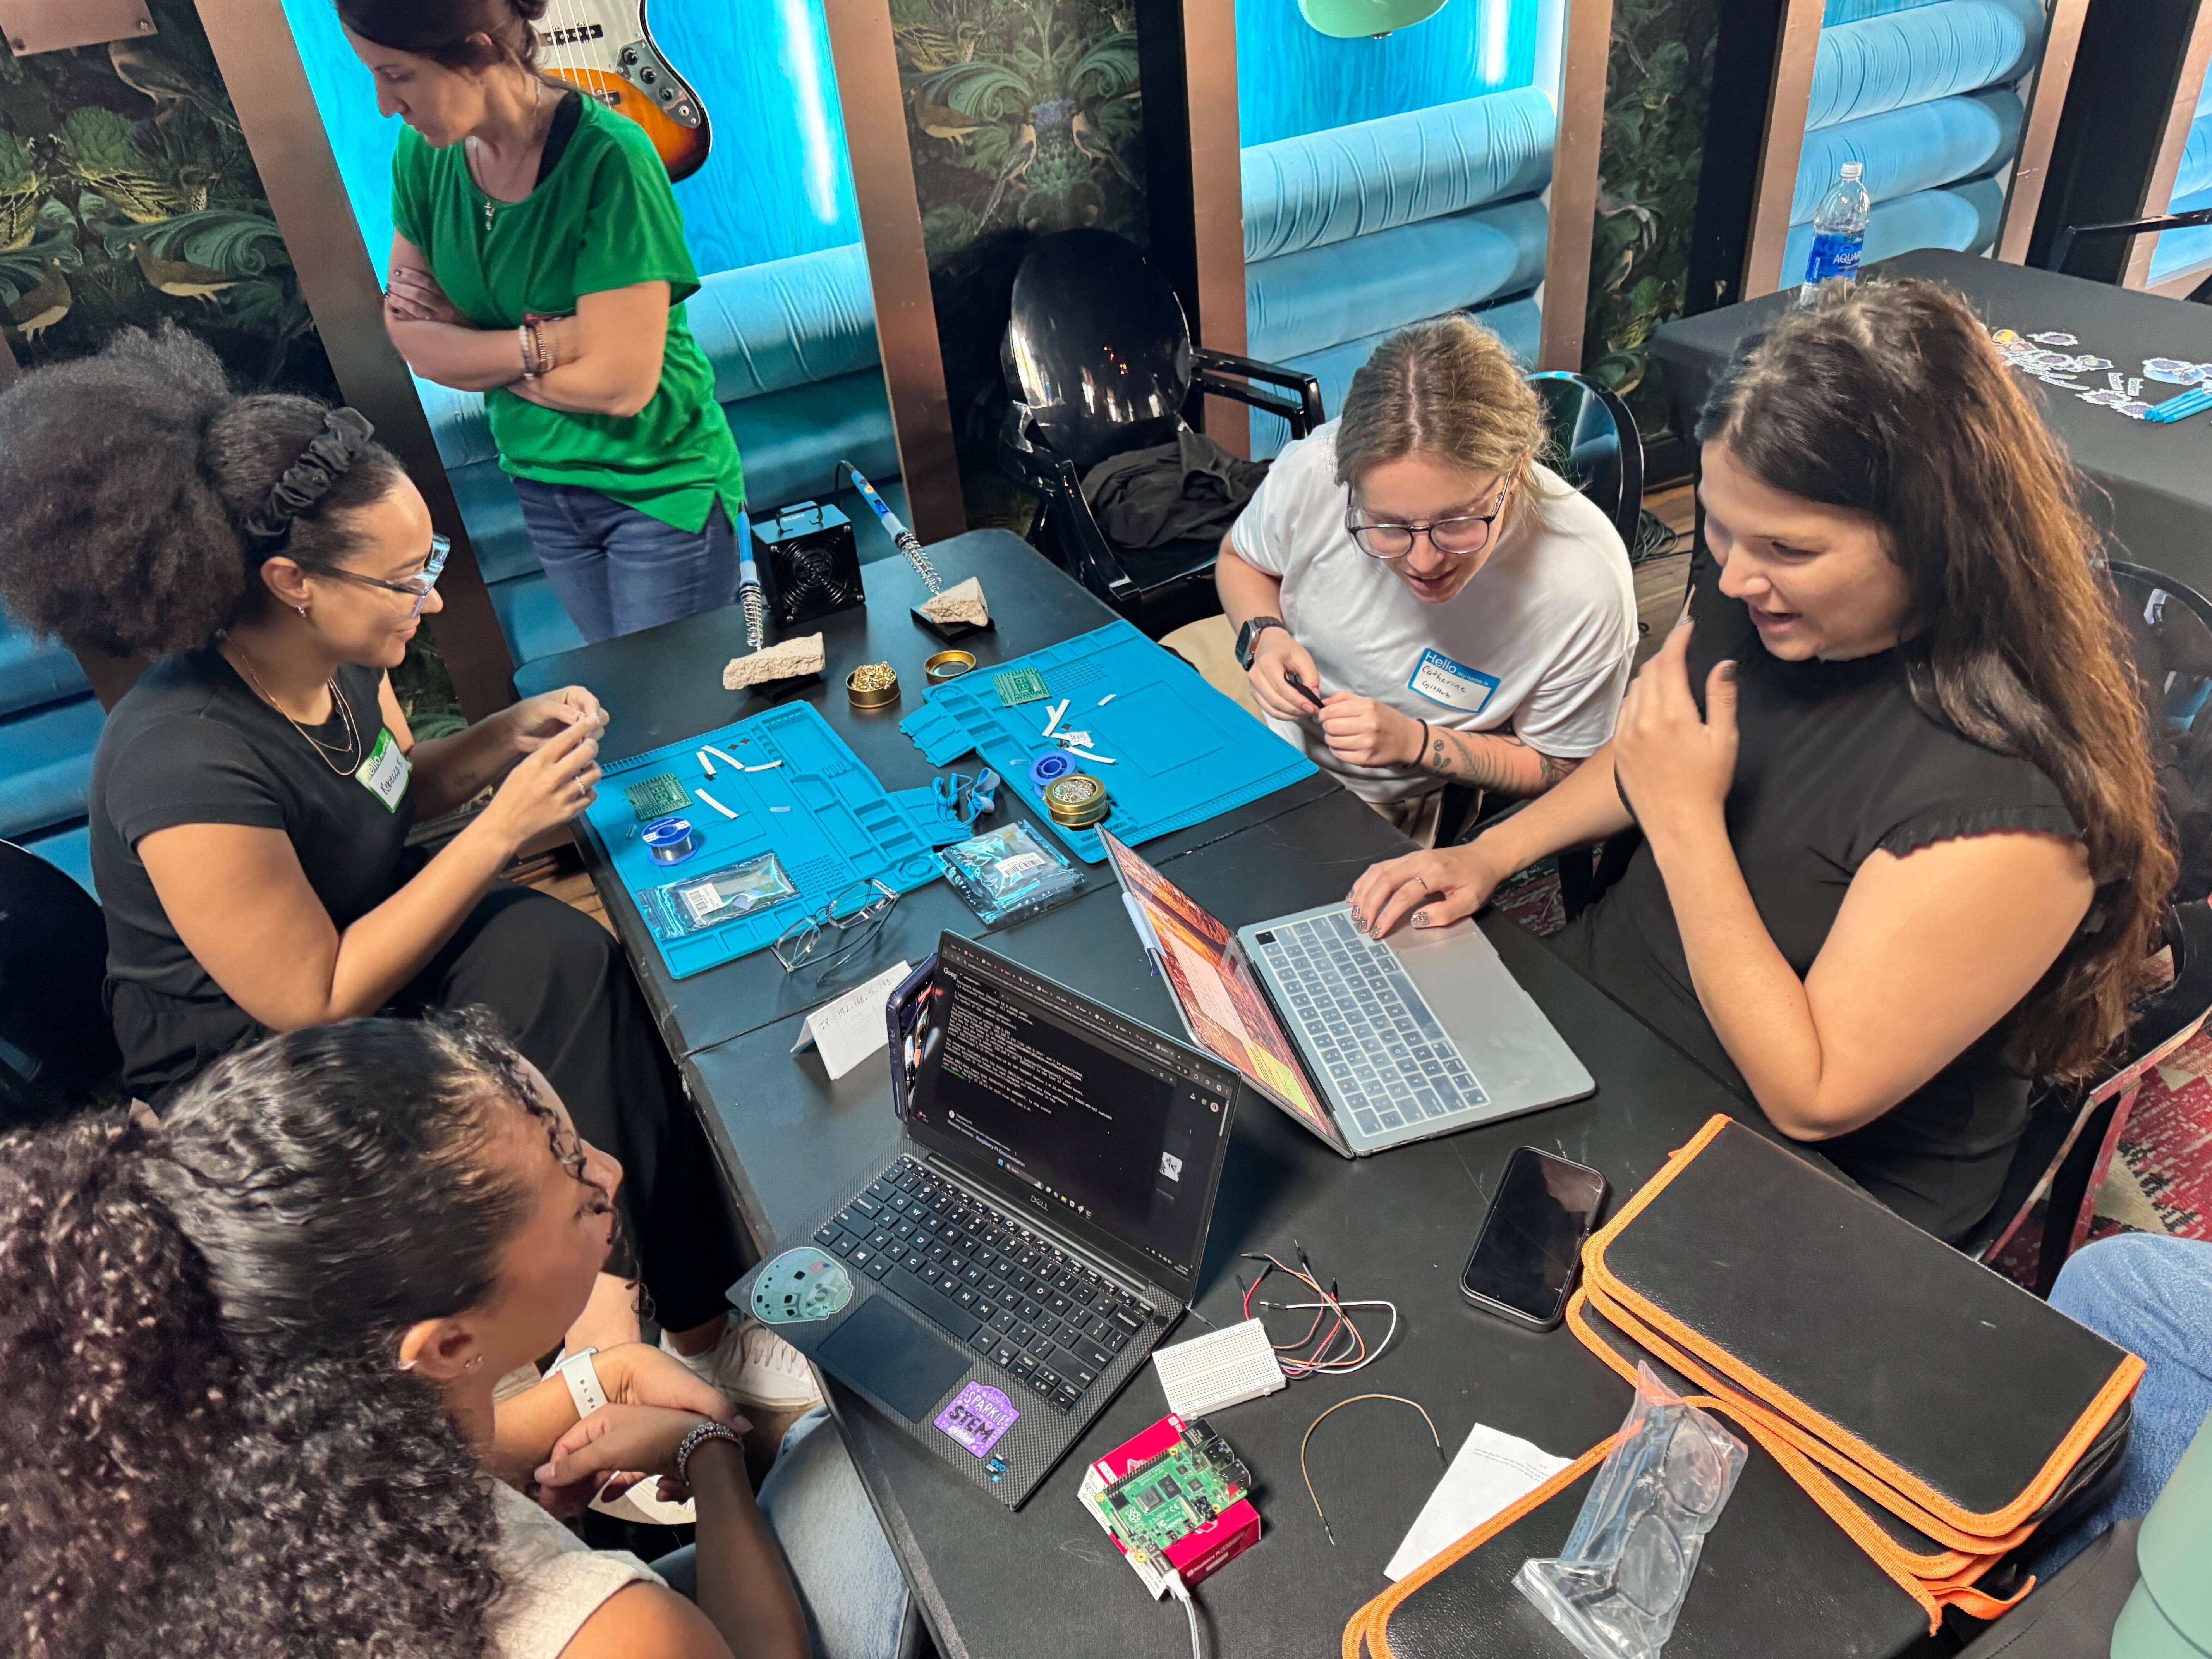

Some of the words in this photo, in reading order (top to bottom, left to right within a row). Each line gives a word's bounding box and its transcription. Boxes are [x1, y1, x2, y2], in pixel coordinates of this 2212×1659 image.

[1425, 651, 1456, 673] Hello
[1467, 676, 1483, 685] name
[1422, 666, 1465, 692] Catherine
[396, 756, 403, 767] K
[1031, 1195, 1048, 1211] DELL
[993, 1390, 1003, 1399] PUT
[963, 1391, 1008, 1426] SPARKLE
[949, 1405, 996, 1443] STEM
[990, 1459, 1006, 1472] evo
